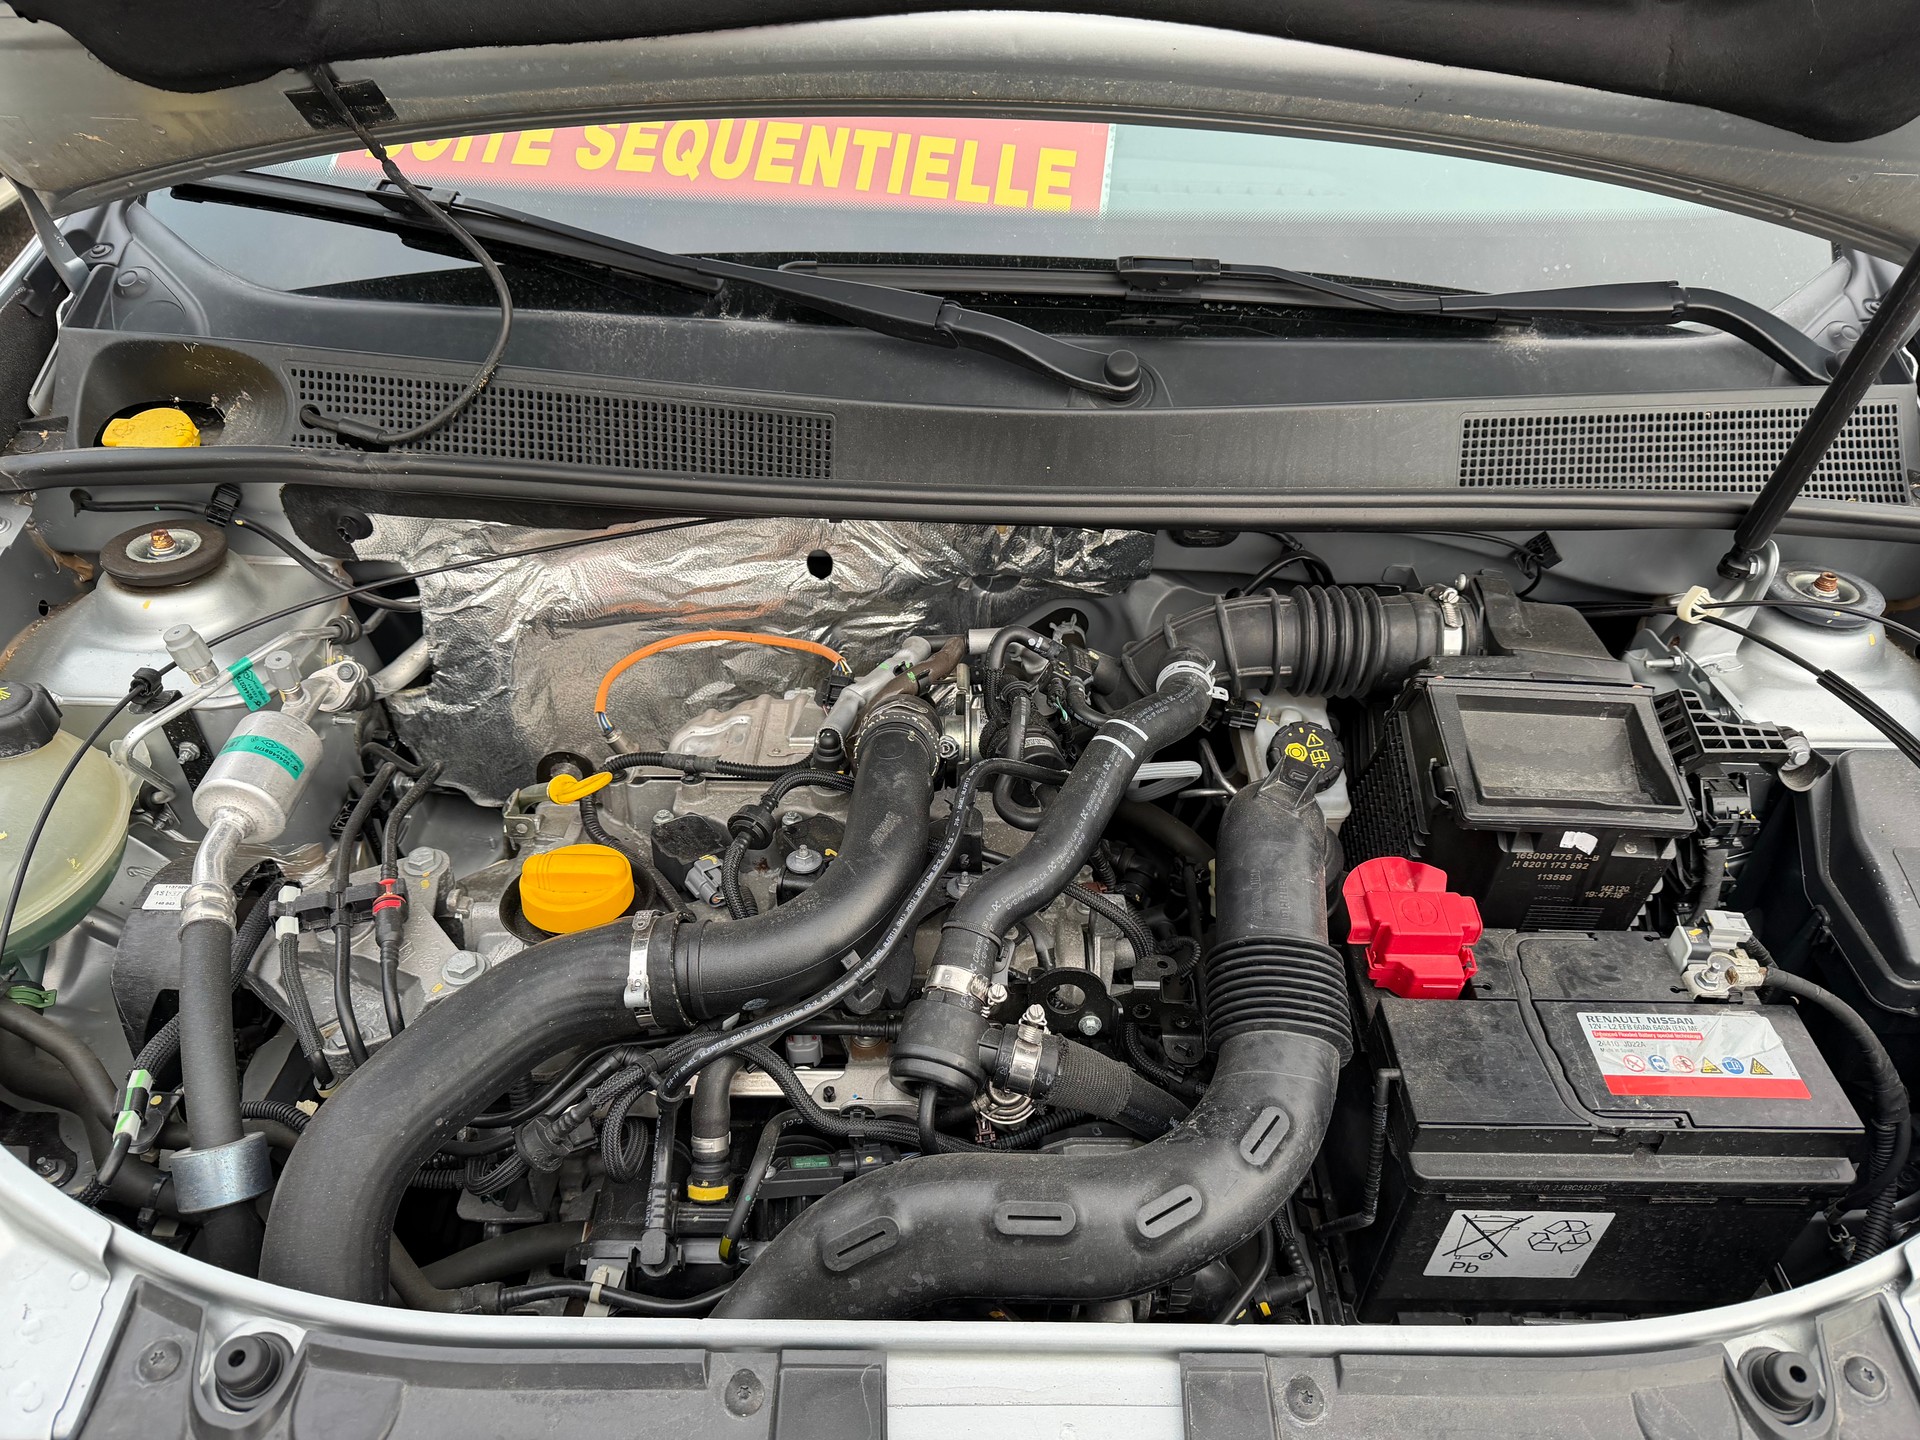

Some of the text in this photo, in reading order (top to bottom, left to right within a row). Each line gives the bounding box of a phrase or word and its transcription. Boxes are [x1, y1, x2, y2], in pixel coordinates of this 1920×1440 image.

[575, 118, 1078, 211] SEQUENTIELLE
[1047, 860, 1057, 873] DC
[1080, 807, 1089, 821] DC
[1522, 861, 1546, 869] 8201
[1569, 862, 1590, 870] 592
[1537, 873, 1573, 881] 113599
[1585, 1015, 1695, 1025] RENAULT NISSAN
[1448, 1261, 1480, 1274] Pb
